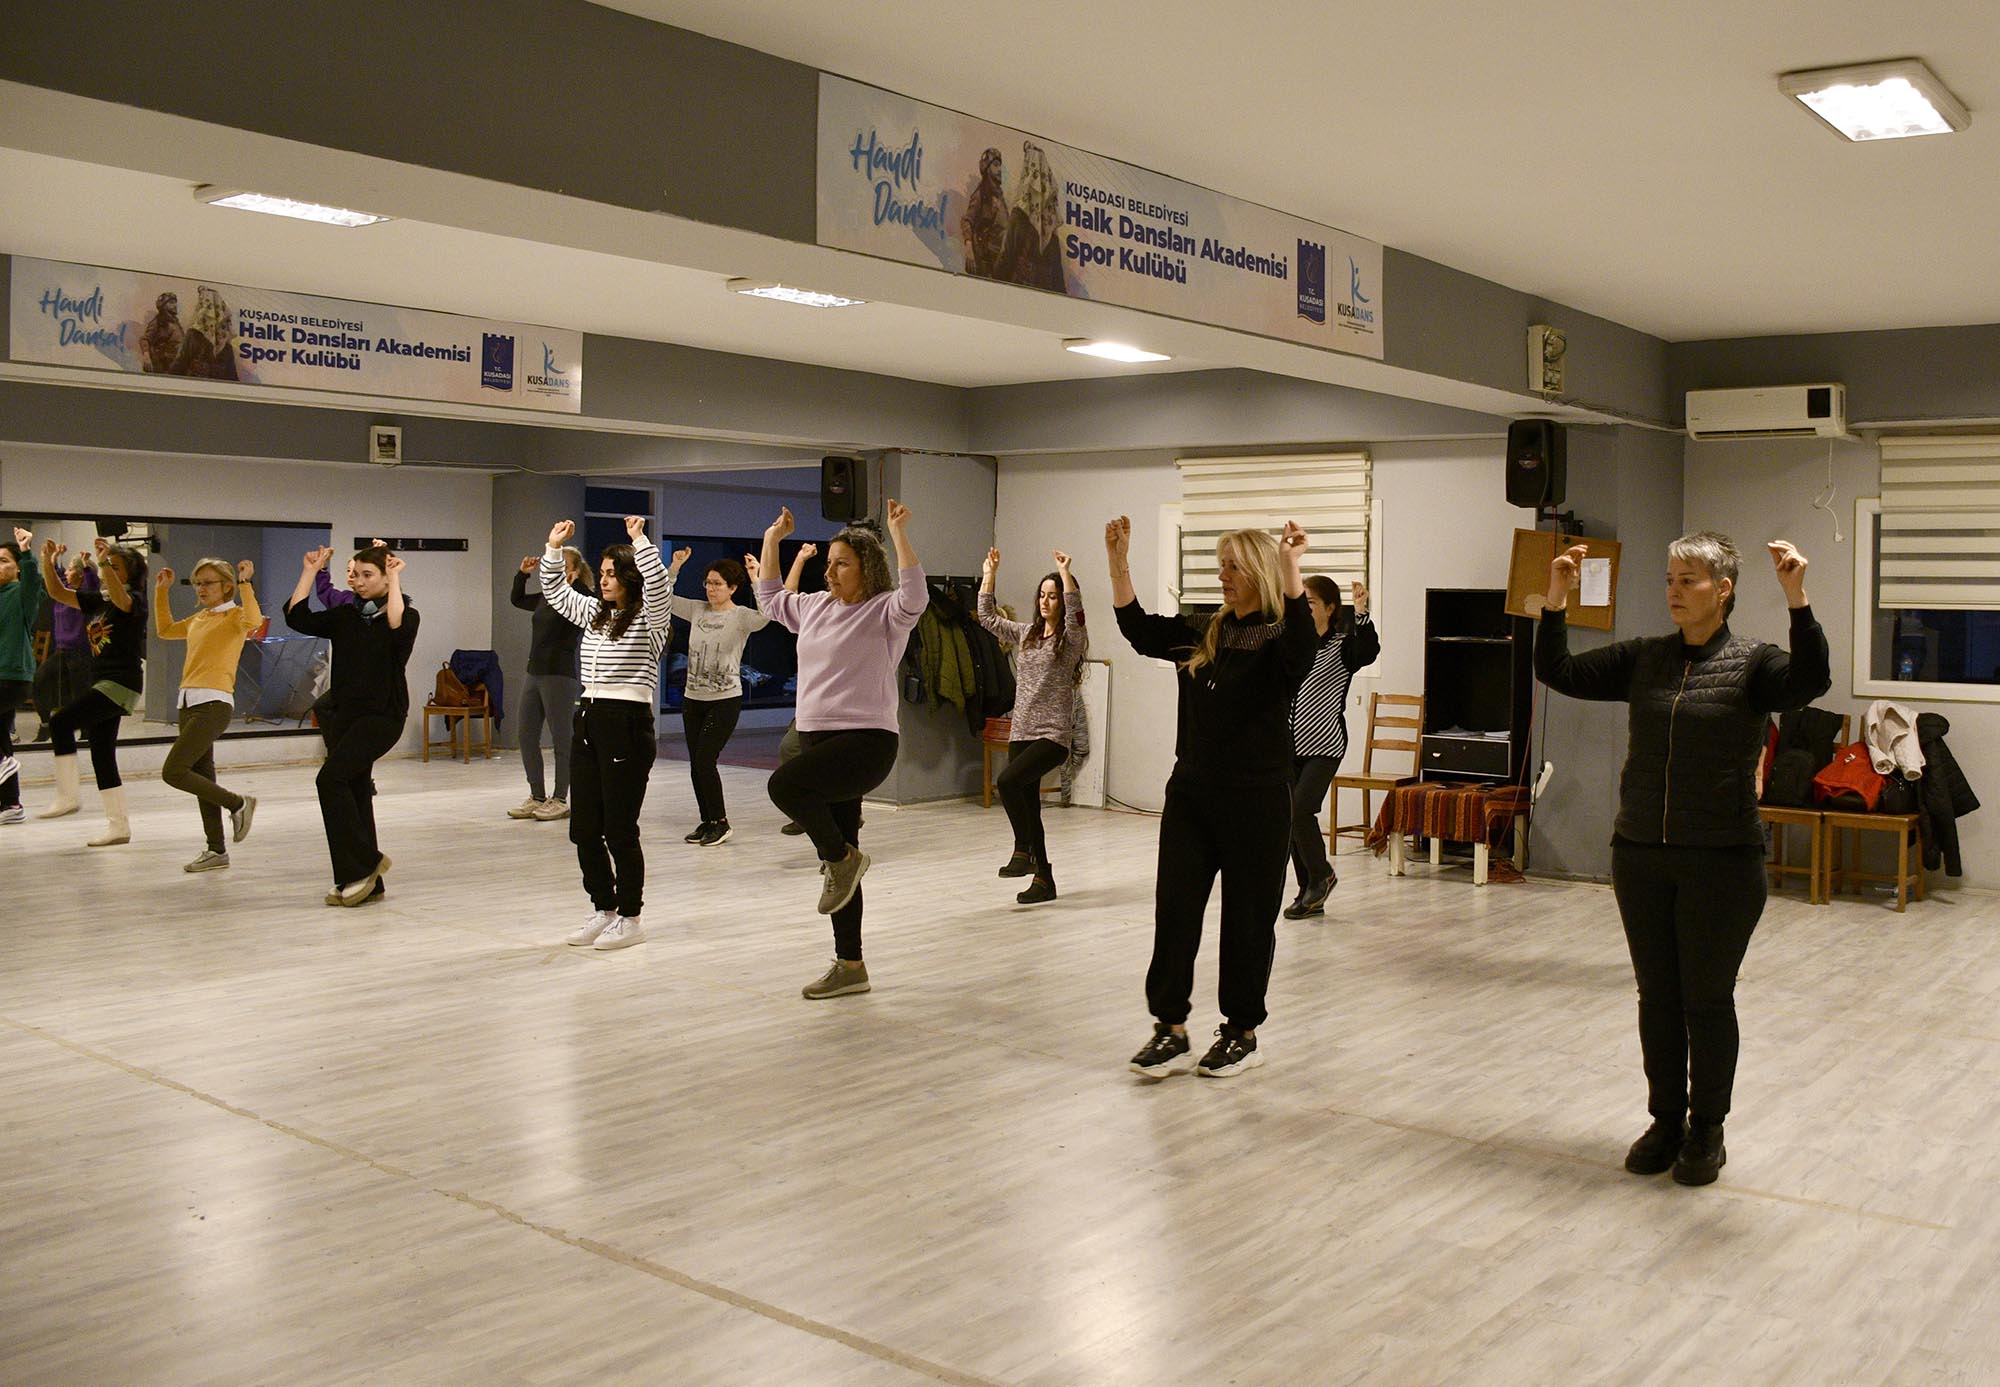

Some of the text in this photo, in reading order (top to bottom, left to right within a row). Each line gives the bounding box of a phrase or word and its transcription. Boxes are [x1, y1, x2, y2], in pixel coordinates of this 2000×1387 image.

[850, 130, 923, 192] Haydi
[873, 180, 948, 240] Dansa!
[1065, 181, 1189, 227] KUŞADASI BELEDİYESİ
[1065, 201, 1288, 280] Halk Dansları Akademisi
[1065, 234, 1187, 284] Spor Kulübü
[39, 286, 104, 324] Haydi
[239, 308, 364, 332] KUŞADASI BELEDİYESİ
[59, 318, 127, 352] Dansa!
[239, 321, 472, 363] Halk Dansları Akademisi
[239, 342, 361, 370] Spor Kulübü
